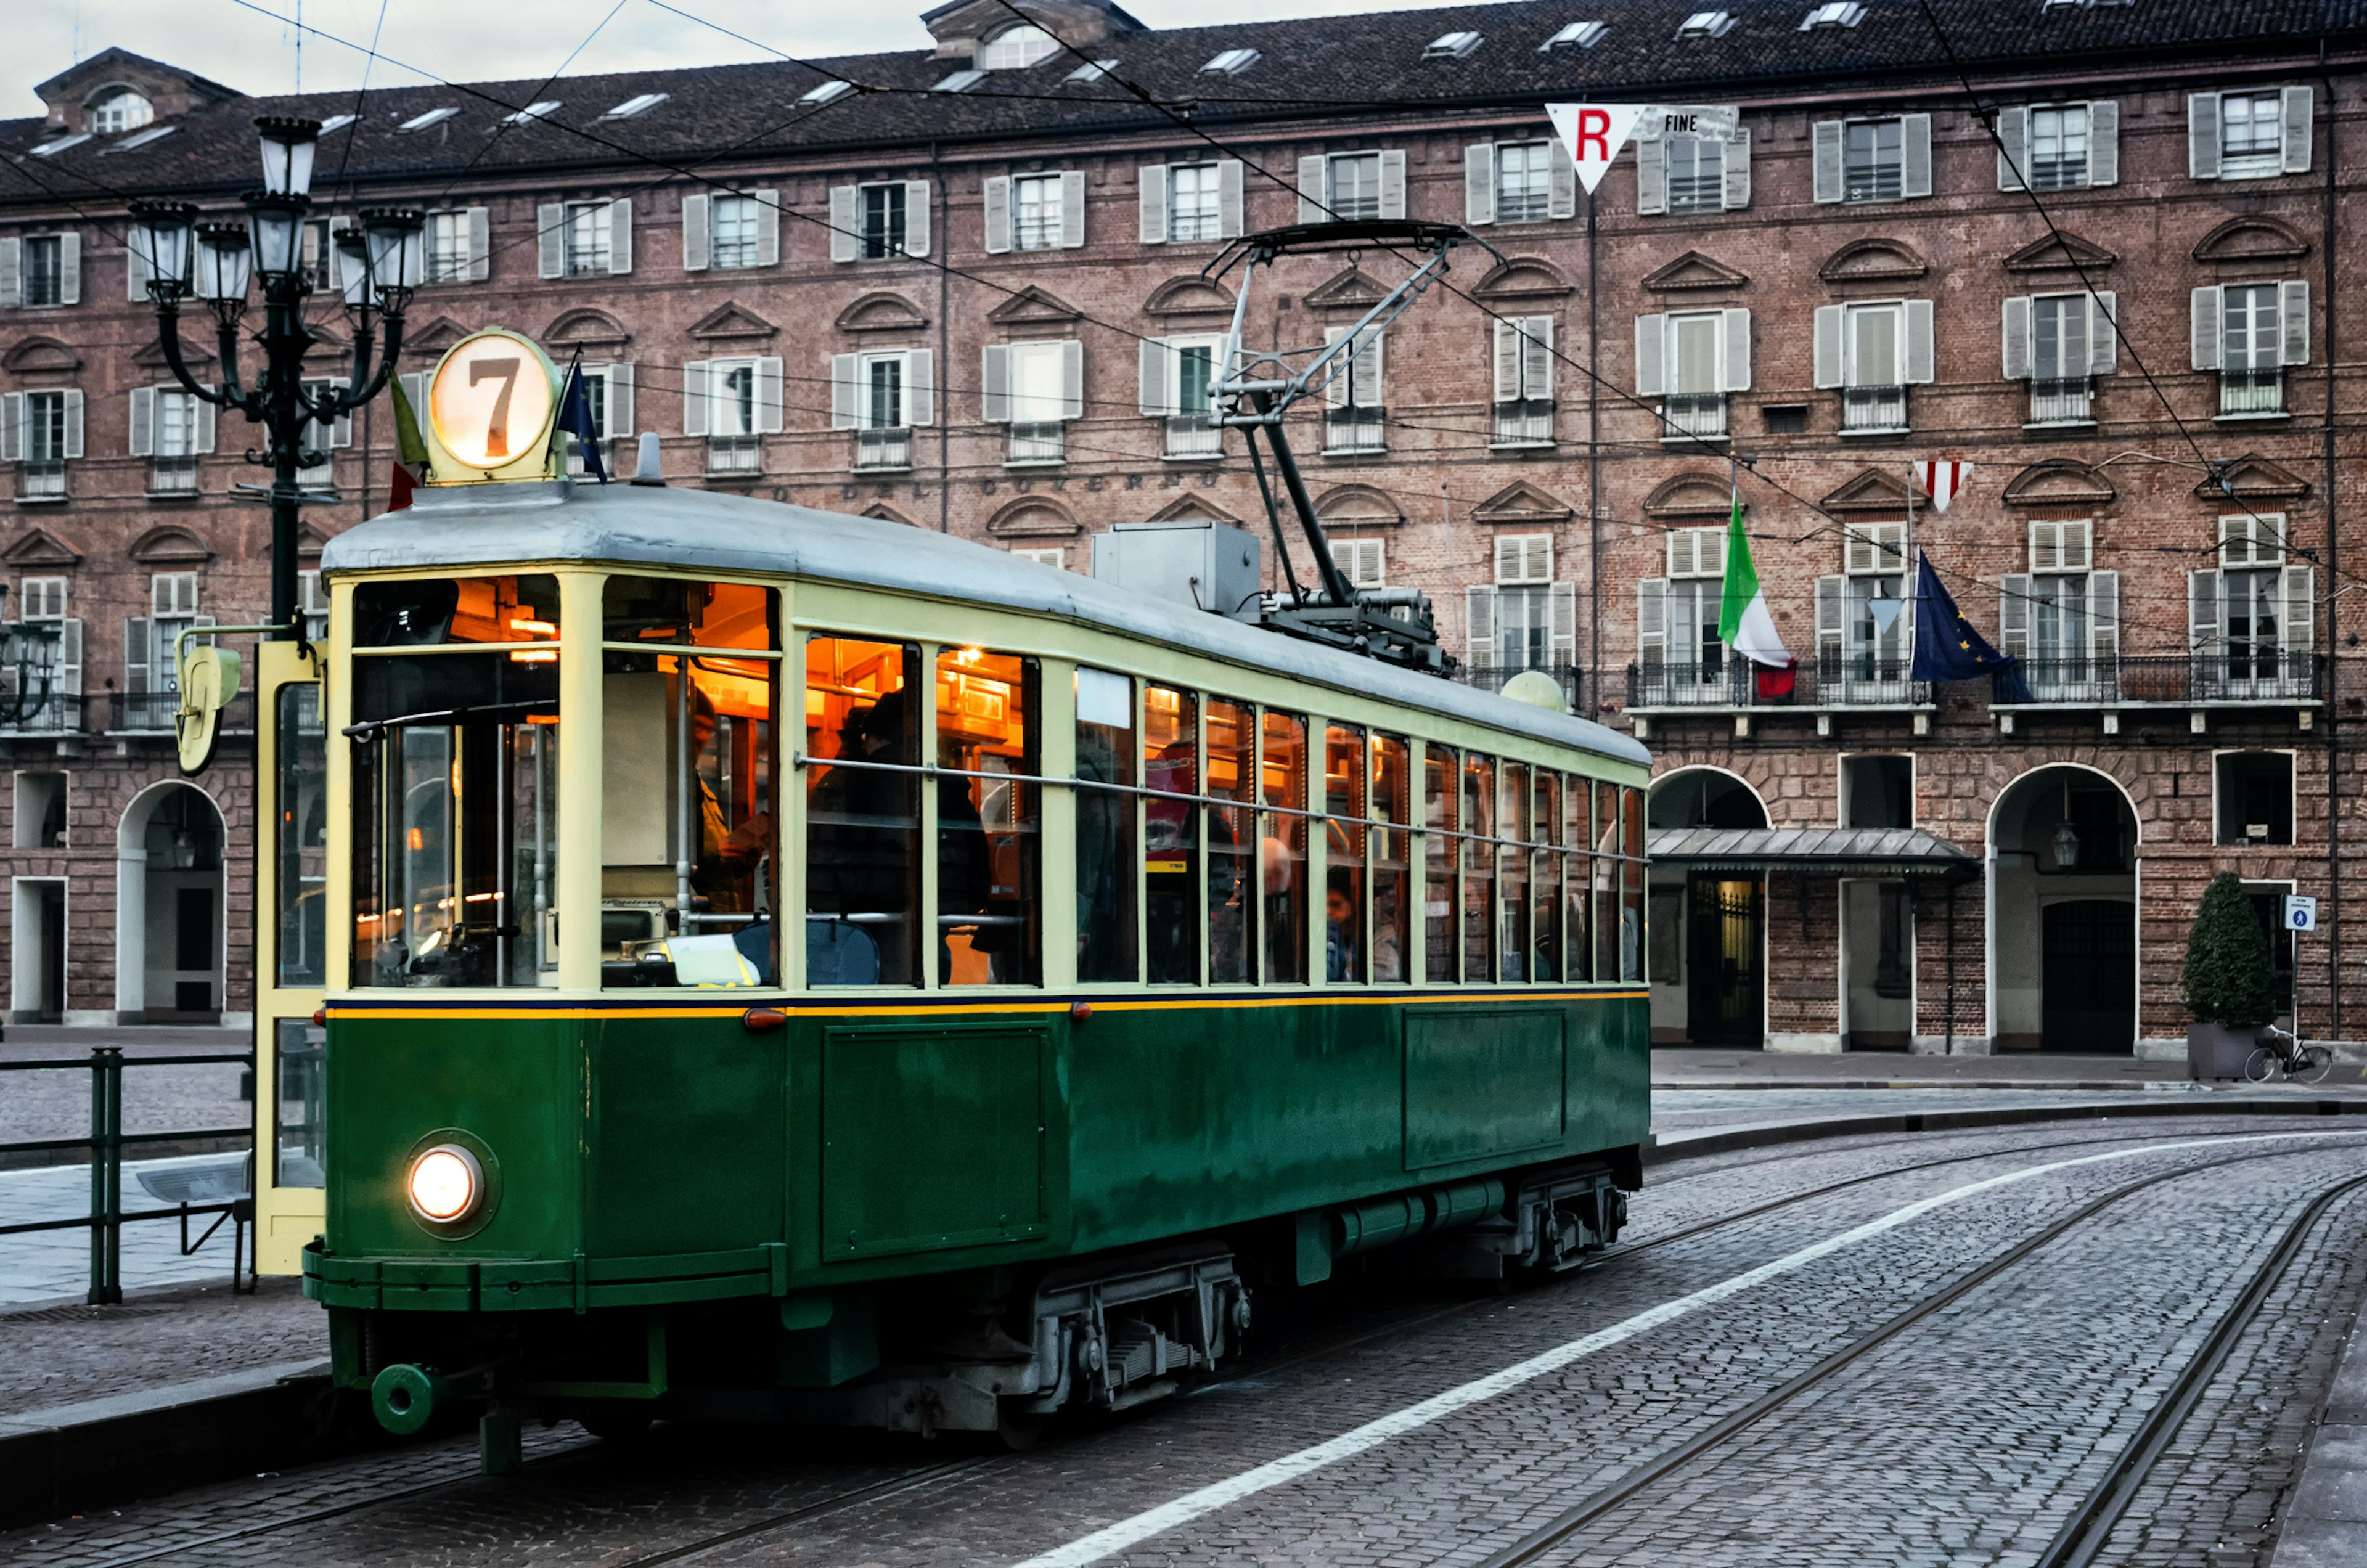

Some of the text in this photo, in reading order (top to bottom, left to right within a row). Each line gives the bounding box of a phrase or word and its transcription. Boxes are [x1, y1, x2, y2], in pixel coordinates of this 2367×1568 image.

[1576, 108, 1611, 161] R
[1666, 115, 1697, 131] FINE
[470, 357, 520, 457] 7
[843, 482, 930, 500] DEL
[981, 470, 1218, 494] GOVERNO
